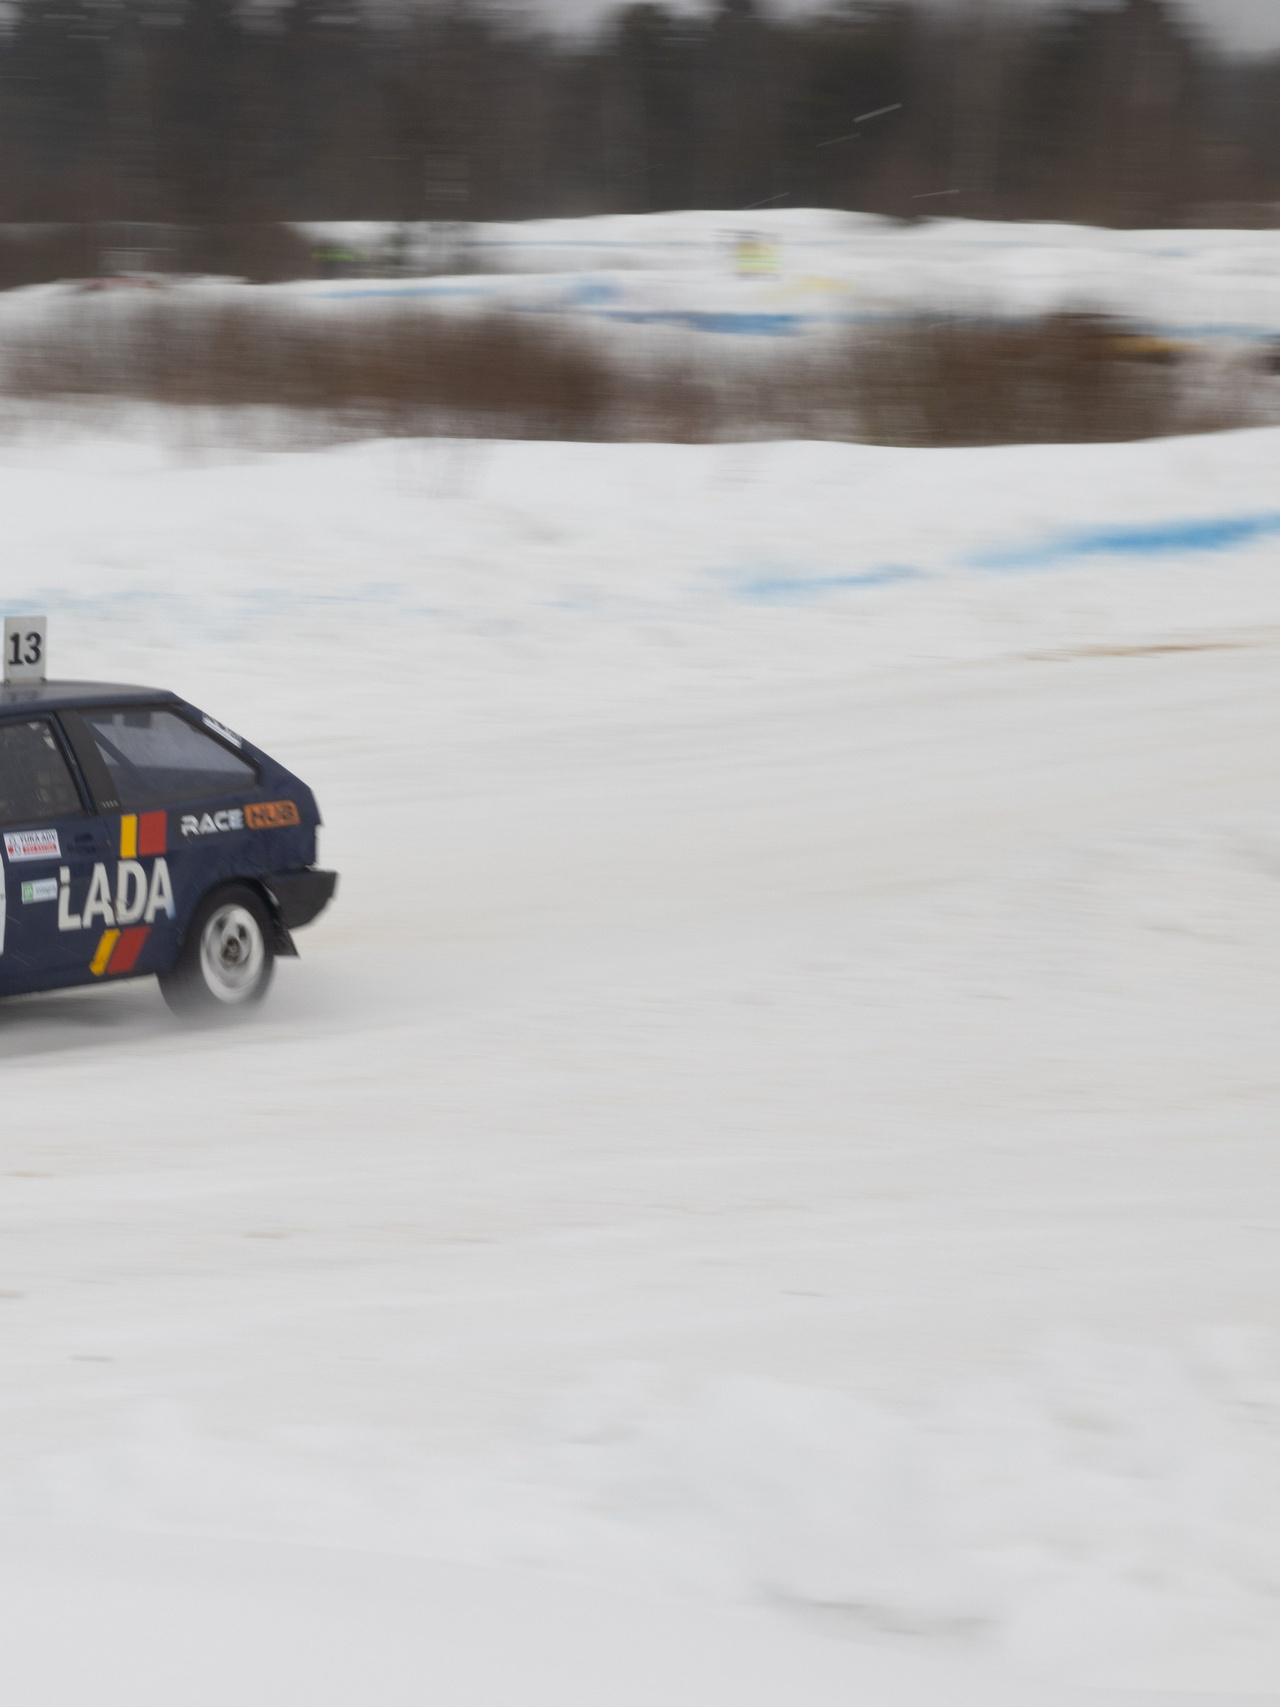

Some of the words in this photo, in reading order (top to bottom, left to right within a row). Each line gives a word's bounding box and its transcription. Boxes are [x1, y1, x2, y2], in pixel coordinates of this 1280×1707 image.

[9, 631, 42, 666] 13
[181, 808, 244, 837] RACE
[58, 857, 176, 931] LADA
